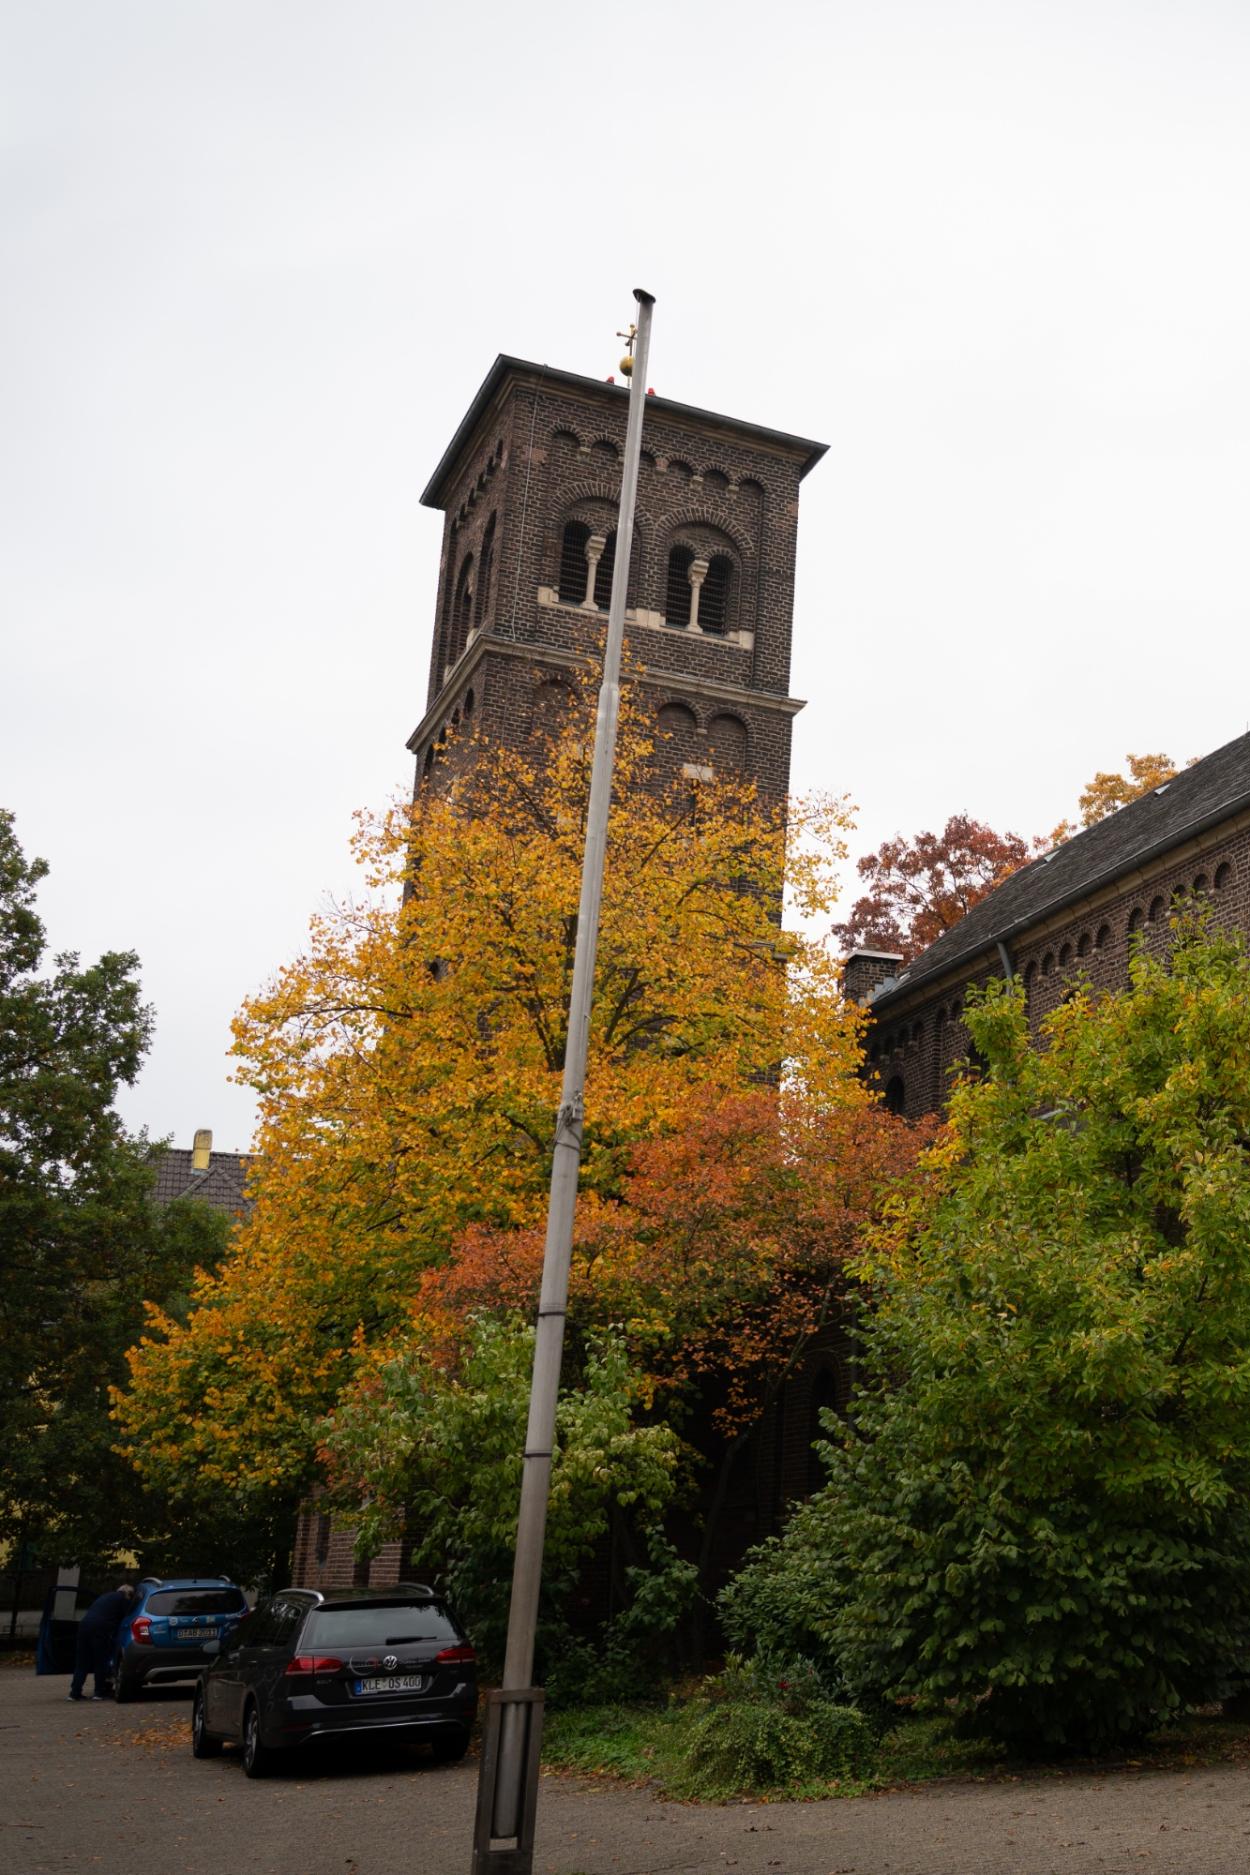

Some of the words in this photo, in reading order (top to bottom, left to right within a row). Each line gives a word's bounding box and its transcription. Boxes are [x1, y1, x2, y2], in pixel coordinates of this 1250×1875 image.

[362, 1679, 381, 1691] KLE
[389, 1678, 401, 1689] OS
[403, 1675, 421, 1688] 400
